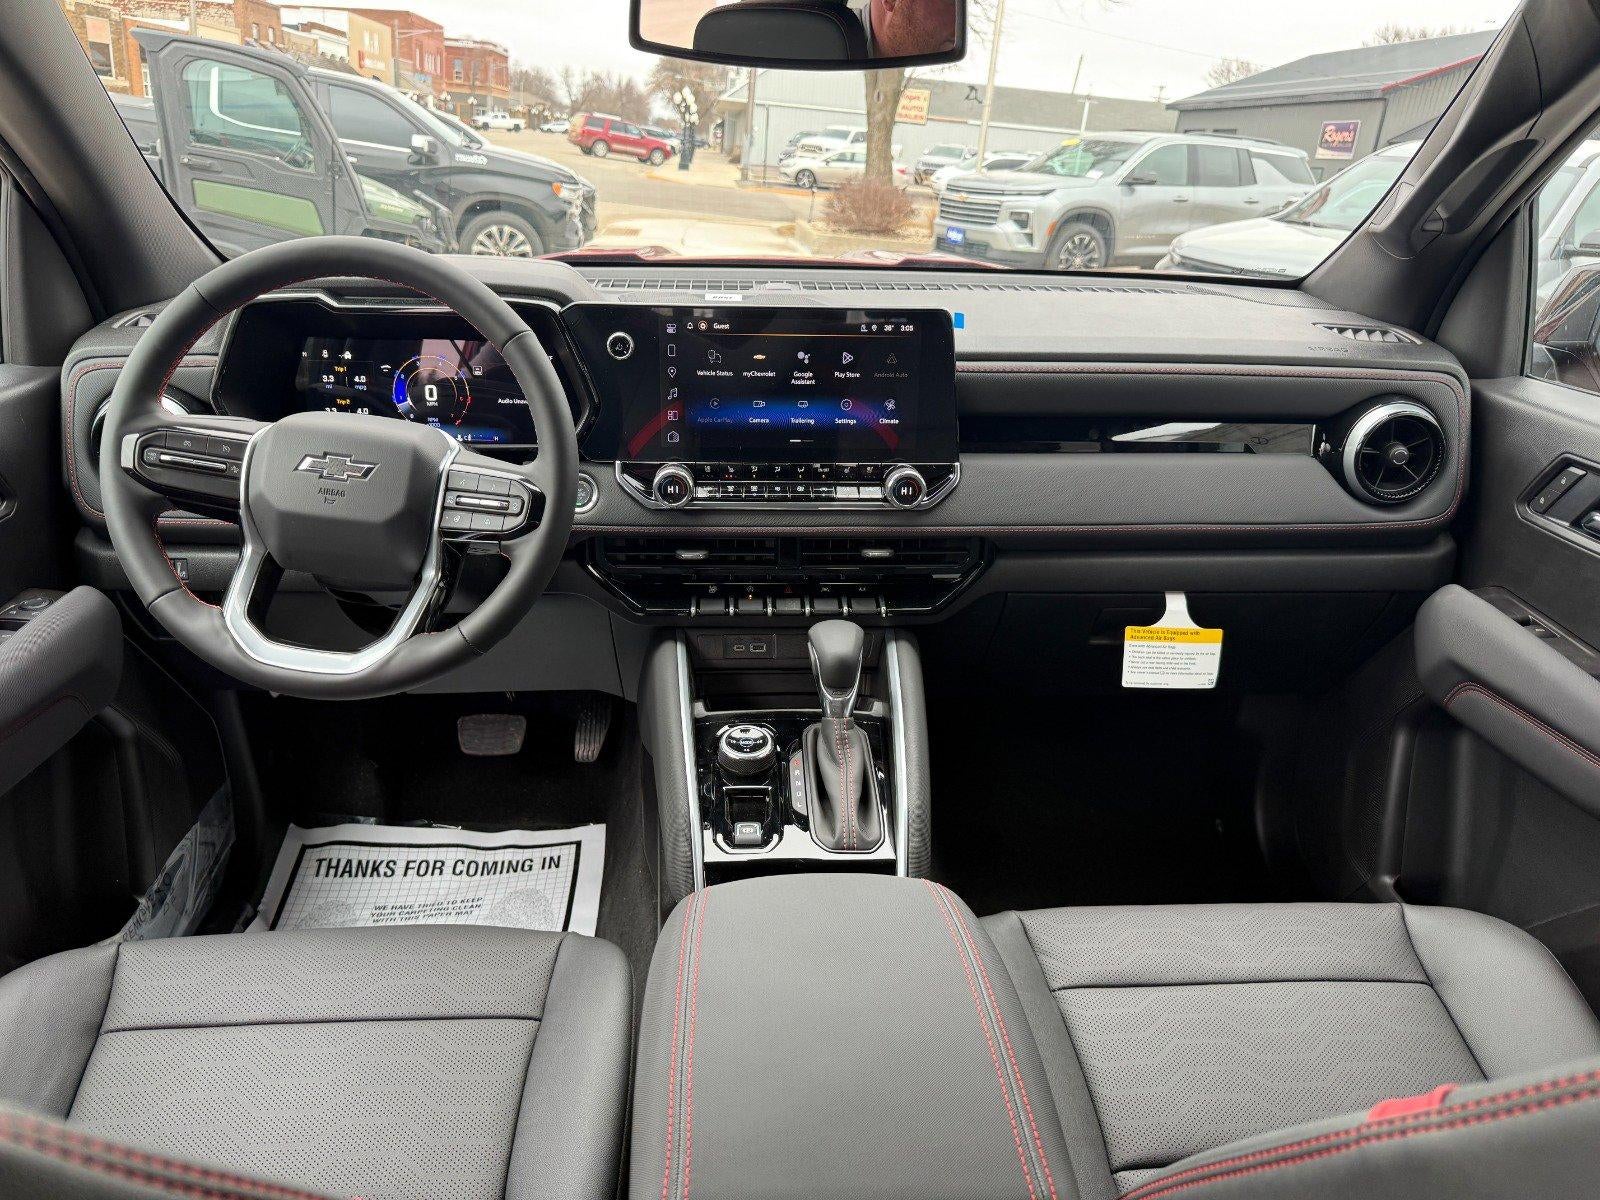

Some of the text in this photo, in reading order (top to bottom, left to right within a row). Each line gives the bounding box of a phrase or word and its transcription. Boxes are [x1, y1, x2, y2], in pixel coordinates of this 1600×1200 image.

[713, 322, 730, 330] Guest
[743, 370, 776, 378] myChevrolet
[354, 375, 366, 383] 4.0
[423, 384, 438, 401] 0
[318, 487, 346, 498] AIRBAG
[667, 485, 679, 494] HI
[900, 486, 912, 495] HI
[314, 855, 562, 878] THANKS FOR COMING IN
[423, 911, 452, 919] PAPER
